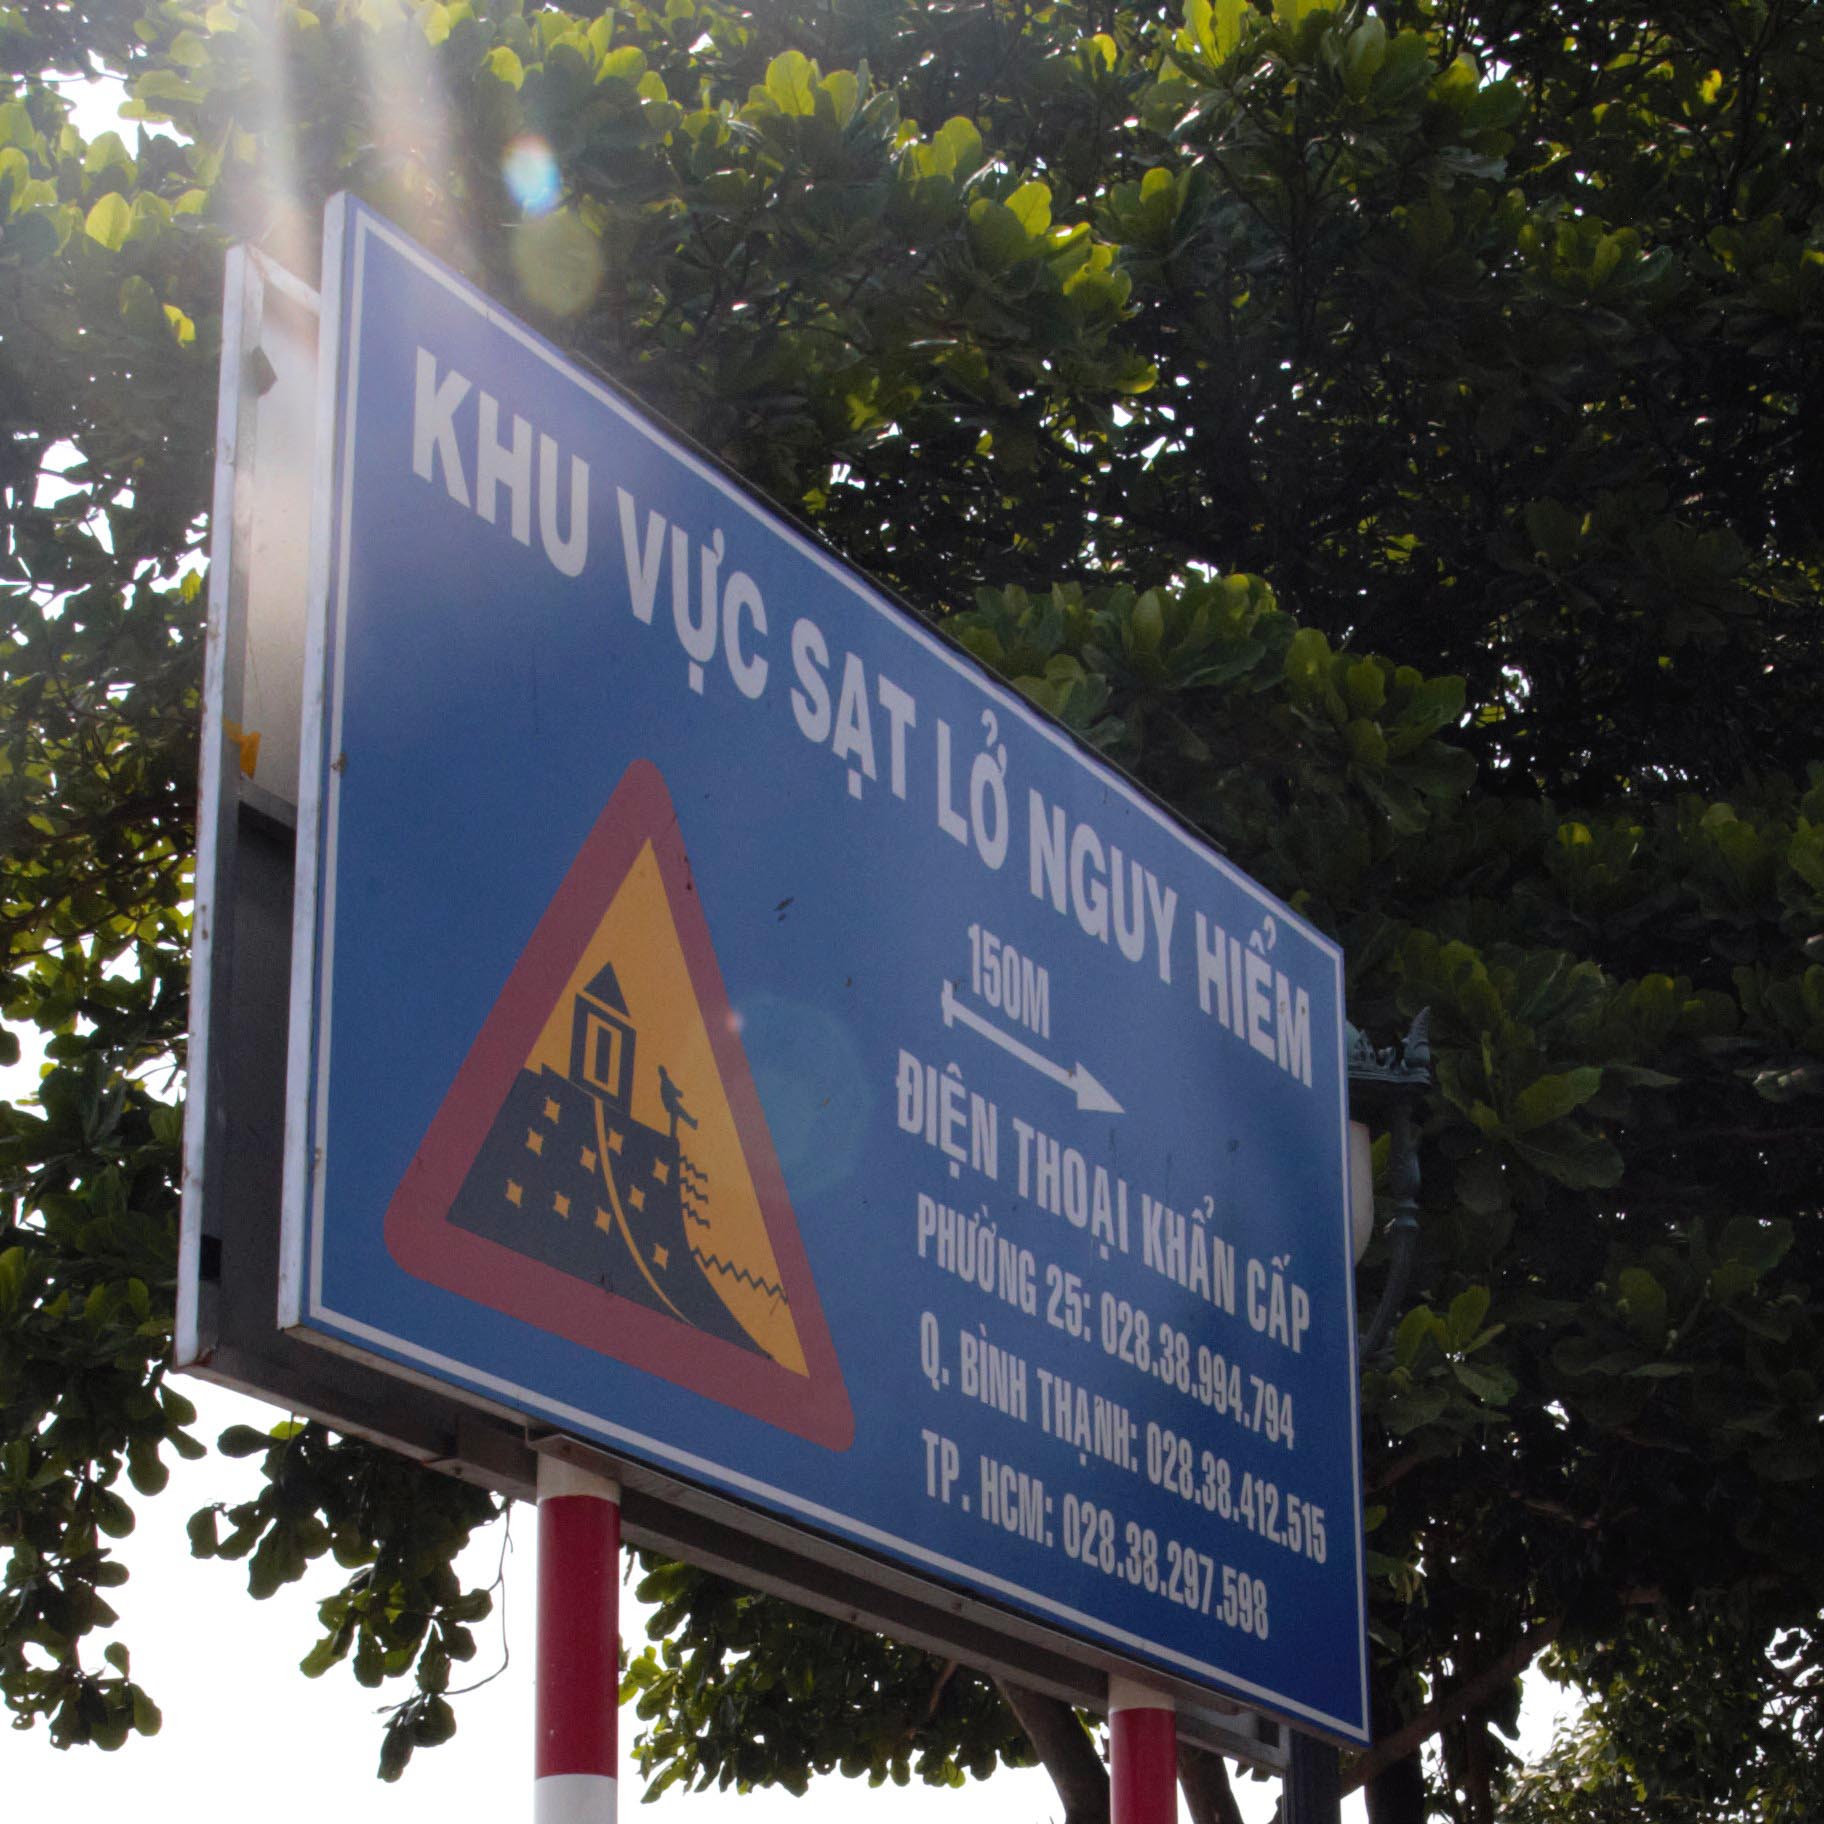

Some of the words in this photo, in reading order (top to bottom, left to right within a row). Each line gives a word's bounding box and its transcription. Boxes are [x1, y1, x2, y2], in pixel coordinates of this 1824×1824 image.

[412, 346, 590, 577] KHU
[616, 485, 770, 699] VỰC
[791, 616, 917, 801] SẠT
[936, 708, 1010, 872] LỞ
[1029, 789, 1178, 984] NGUY
[1195, 911, 1314, 1088] HIỂM
[968, 923, 1050, 1039] 150M
[896, 1048, 998, 1180] ĐIỆN
[1013, 1117, 1129, 1258] THOẠI
[1142, 1194, 1236, 1315] KHẨN
[1247, 1250, 1310, 1354] CẤP
[917, 1193, 1036, 1316] PHƯỜNG
[1046, 1264, 1092, 1340] 25:
[1101, 1291, 1294, 1451] 028.38.994.794
[921, 1311, 950, 1390] Q.
[960, 1321, 1028, 1423] BÌNH
[1037, 1367, 1139, 1472] THẠNH:
[1146, 1422, 1327, 1565] 028.38.412.515
[921, 1428, 970, 1514] TP.
[981, 1453, 1054, 1548] HCM:
[1063, 1493, 1270, 1642] 028.38.297.598
